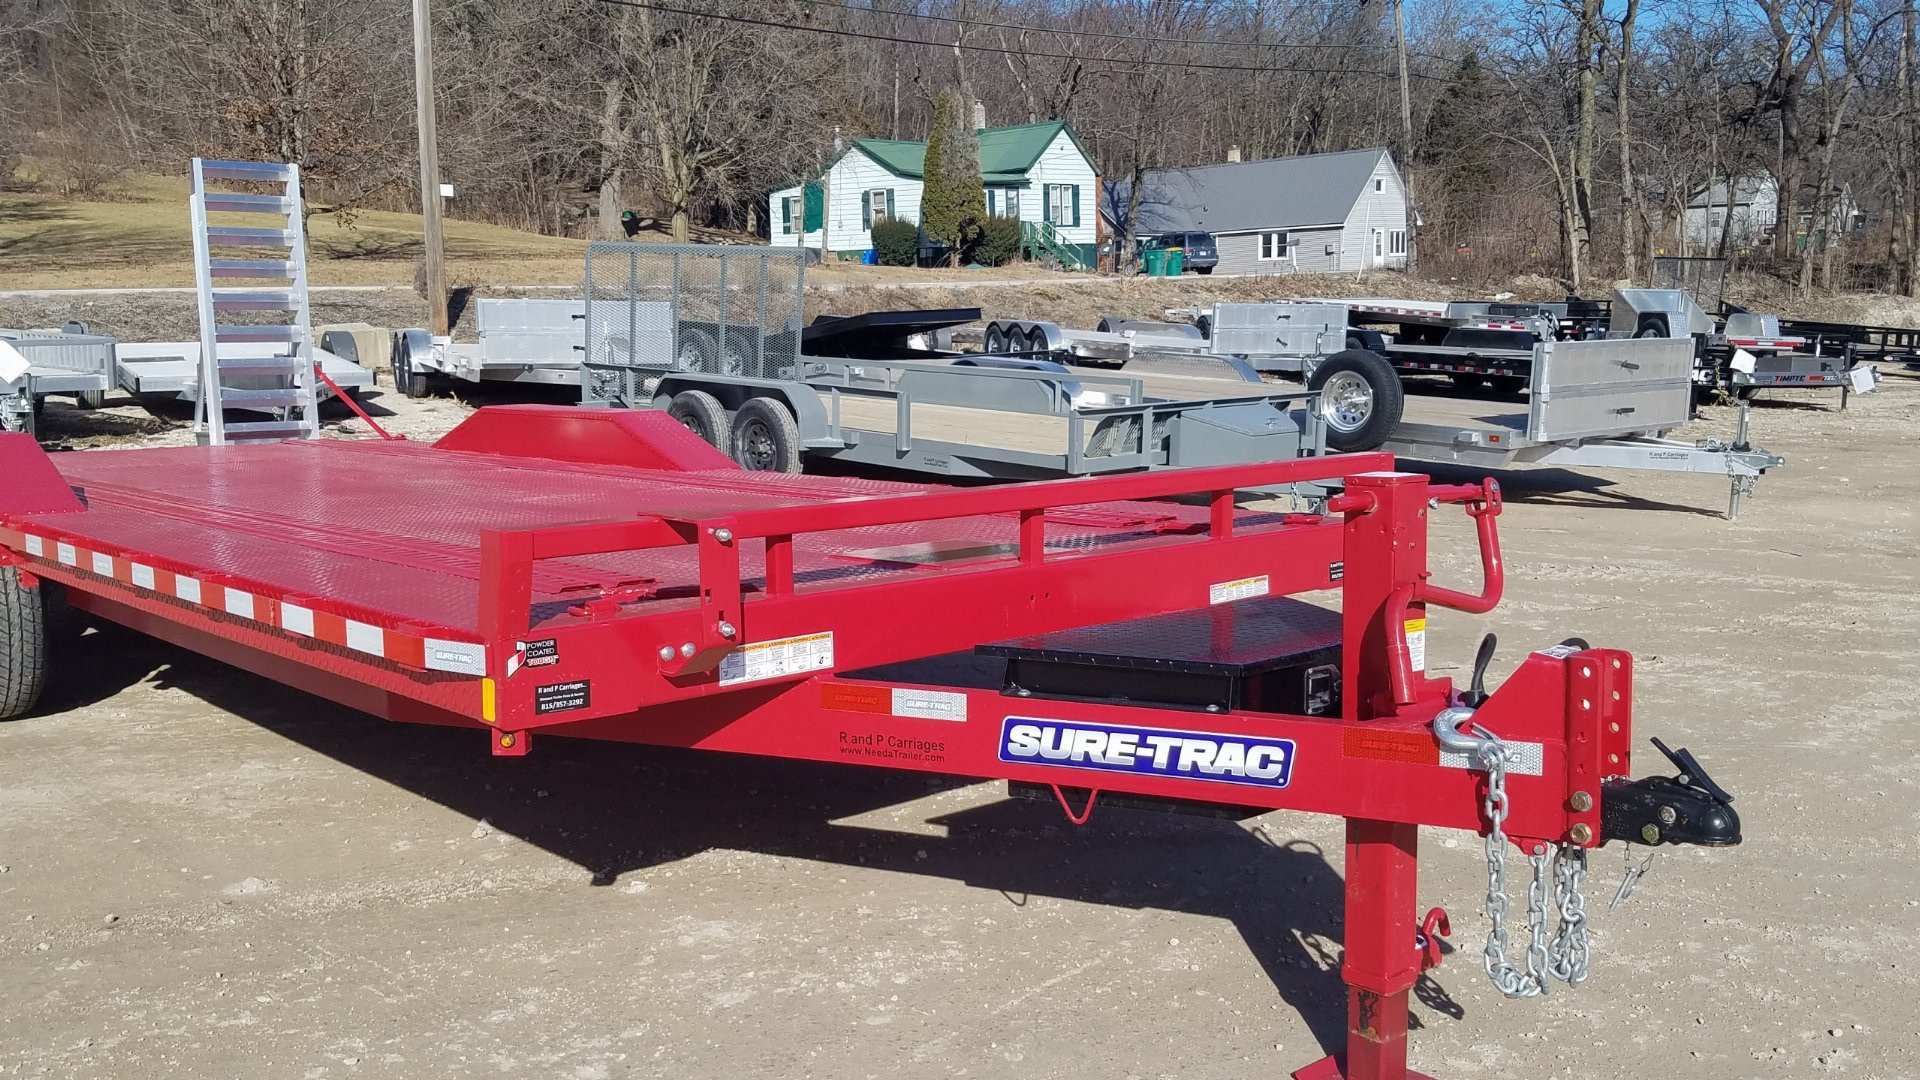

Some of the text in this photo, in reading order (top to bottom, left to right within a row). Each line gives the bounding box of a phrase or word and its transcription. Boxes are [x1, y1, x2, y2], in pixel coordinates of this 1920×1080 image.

[526, 640, 555, 650] POWDER
[436, 651, 473, 663] SURE-TRAC
[527, 647, 555, 658] COATED
[543, 685, 554, 693] and
[541, 698, 584, 710] 815/357-3292
[906, 699, 951, 711] SURE-TRAC
[840, 731, 945, 753] R and P Carriages
[840, 746, 945, 763] www.NeedaTrailer.com
[1007, 724, 1285, 780] SURE-TRAC
